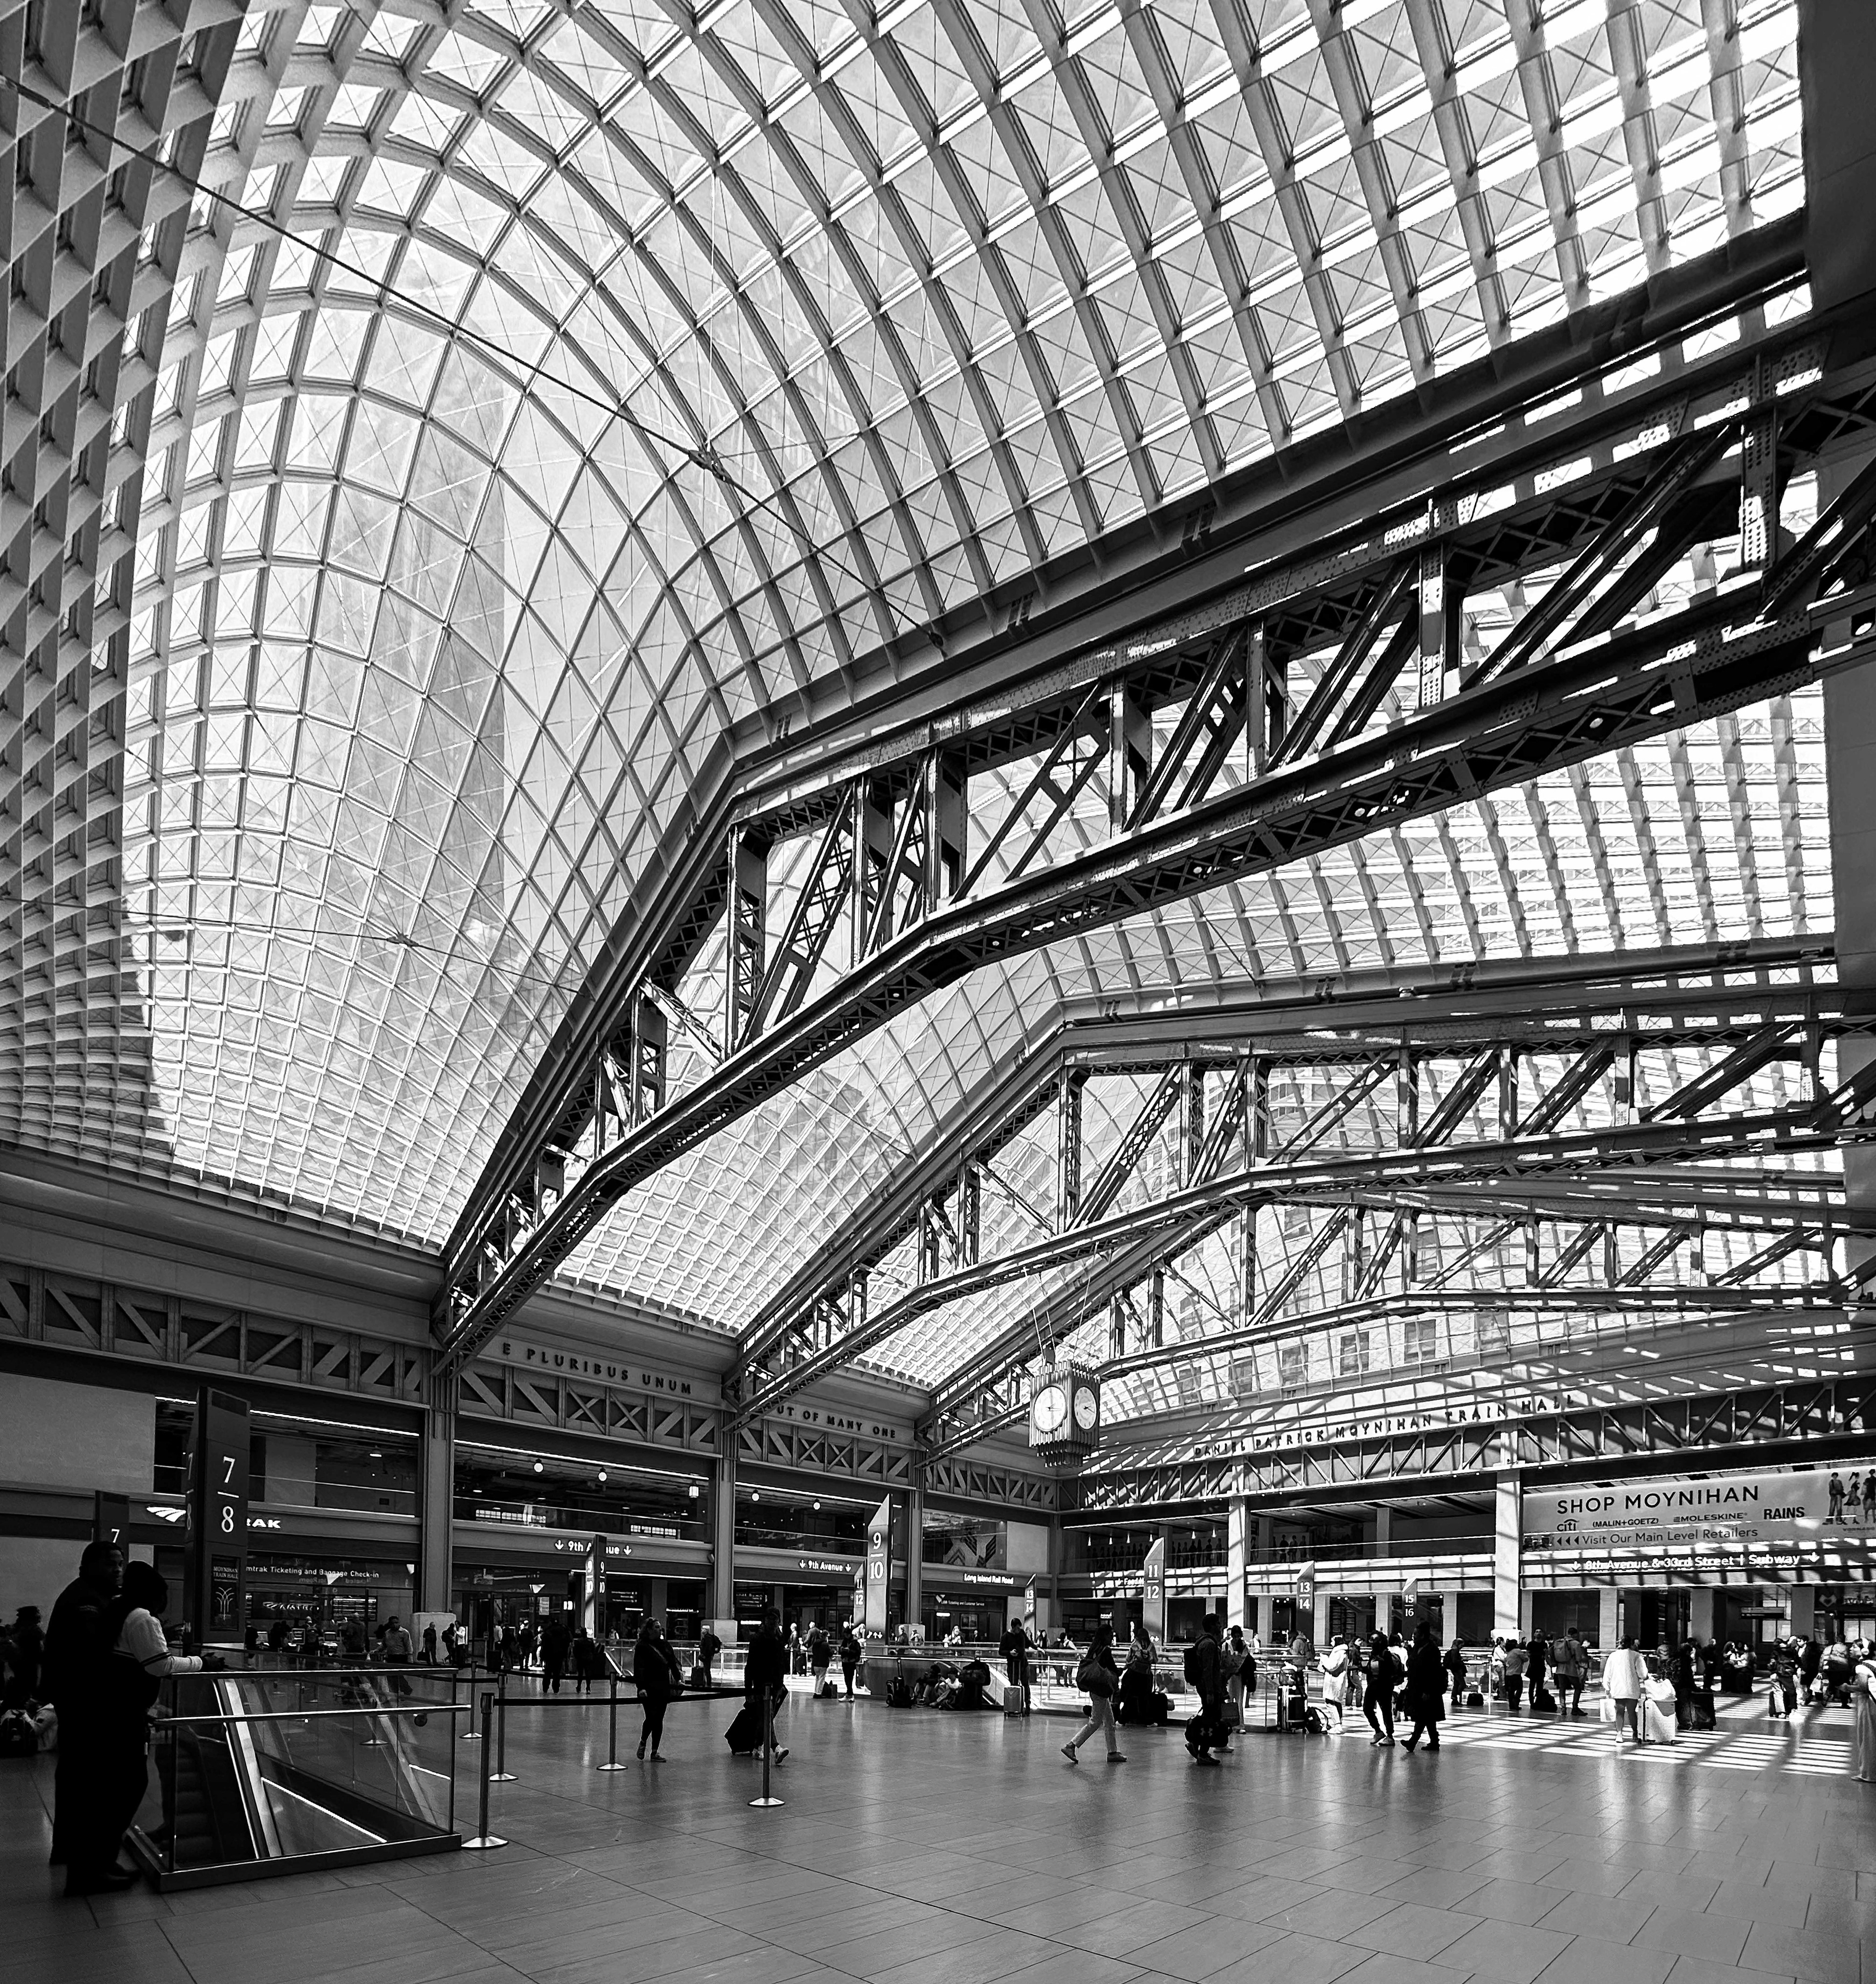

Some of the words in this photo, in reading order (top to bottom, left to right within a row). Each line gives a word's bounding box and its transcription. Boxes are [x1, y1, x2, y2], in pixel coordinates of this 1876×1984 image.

[503, 1342, 511, 1355] E
[527, 1348, 629, 1380] PLURIBUS
[641, 1374, 692, 1394] UNUM
[777, 1405, 794, 1416] UT
[803, 1410, 819, 1422] OF
[827, 1415, 862, 1431] MANY
[873, 1426, 895, 1439] ONE
[1194, 1440, 1246, 1456] DANIEL
[1256, 1429, 1324, 1449] PATRICK
[1336, 1414, 1431, 1438] MOYNIHAN
[1445, 1403, 1507, 1422] TRAIN
[1521, 1394, 1574, 1411] HALL
[223, 1455, 235, 1483] 7
[1557, 1496, 1615, 1514] SHOP
[1625, 1485, 1758, 1510] MOYNIHAN
[1681, 1512, 1744, 1522] MOLESKINE
[1763, 1507, 1805, 1519] RAINS
[221, 1506, 234, 1533] 8
[1556, 1519, 1579, 1531] citi
[1593, 1517, 1659, 1528] (MALIN+GOETZ)
[111, 1528, 120, 1543] 7
[873, 1532, 882, 1550] 9
[1582, 1535, 1606, 1544] Visit
[1610, 1533, 1632, 1544] Our
[1635, 1532, 1663, 1542] Main
[1667, 1529, 1698, 1540] Level
[1703, 1527, 1758, 1539] Retailers
[568, 1540, 584, 1552] 9th
[600, 1561, 605, 1573] 9
[808, 1560, 819, 1570] 9th
[820, 1561, 843, 1572] Avenue
[1608, 1560, 1649, 1569] Avenue
[1651, 1558, 1661, 1568] &
[1663, 1557, 1693, 1568] 33rd
[1695, 1556, 1734, 1566] Street
[1748, 1554, 1800, 1565] Subway
[270, 1566, 302, 1575] Ticketing
[350, 1570, 379, 1578] Check-in
[870, 1561, 884, 1579] 10
[1149, 1564, 1158, 1577] 11
[599, 1581, 605, 1594] 10
[856, 1578, 863, 1589] 11
[1300, 1582, 1310, 1593] 13
[1026, 1590, 1034, 1598] 13
[1147, 1585, 1159, 1599] 12
[855, 1595, 863, 1605] 12
[1299, 1598, 1310, 1609] 14
[1405, 1595, 1414, 1603] 15
[1026, 1603, 1034, 1613] 14
[1405, 1608, 1414, 1617] 16
